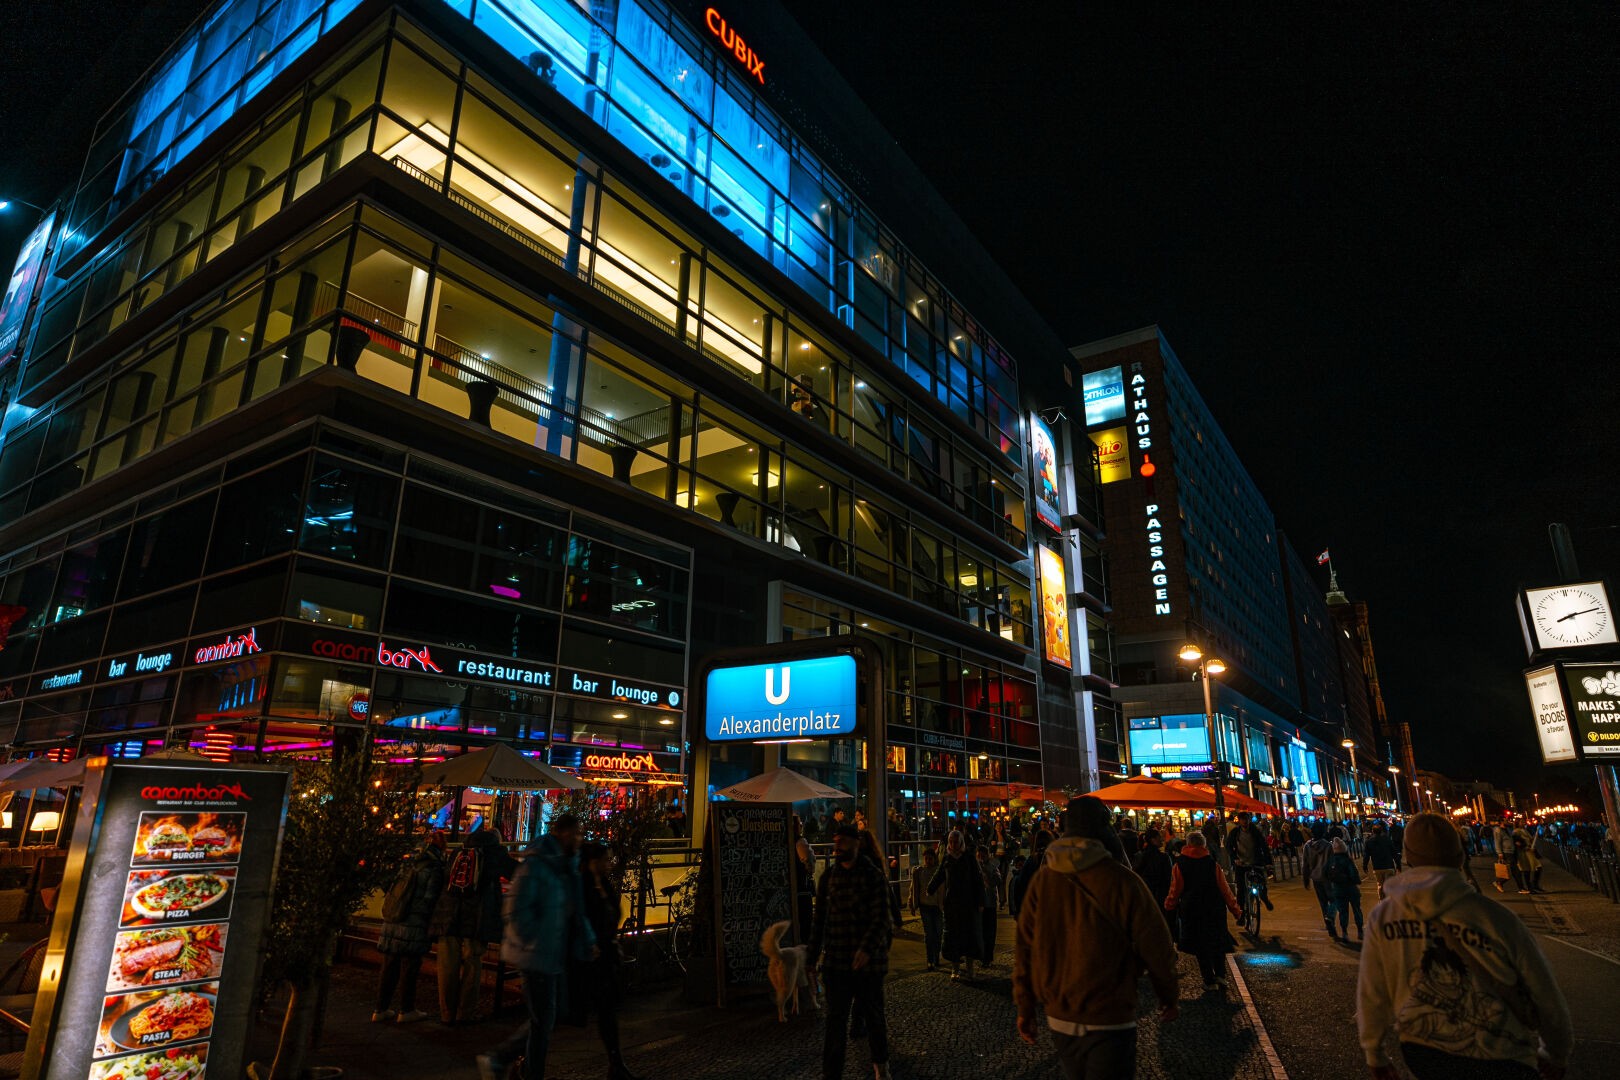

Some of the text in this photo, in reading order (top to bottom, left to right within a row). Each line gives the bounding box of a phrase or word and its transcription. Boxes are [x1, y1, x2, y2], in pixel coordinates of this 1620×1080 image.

[705, 7, 766, 85] CUBIX
[1131, 362, 1152, 449] RATHAUS
[1146, 504, 1171, 615] PASSAGEN
[40, 652, 172, 690] restaurant bar lounge
[457, 659, 551, 686] restaurant
[572, 673, 600, 695] bar
[611, 679, 659, 705] lounge
[765, 666, 791, 706] U
[1541, 703, 1549, 711] Do
[1577, 700, 1616, 711] MAKES
[718, 709, 841, 736] Alexanderplatz
[1540, 710, 1566, 725] BOOBS
[1591, 713, 1620, 723] HAPP
[1599, 733, 1620, 741] DILDO
[172, 851, 206, 860] BURGER
[166, 909, 190, 919] PIZZA
[1383, 919, 1424, 940] ONE
[154, 969, 181, 980] STEAK
[141, 1031, 171, 1043] PASTA
